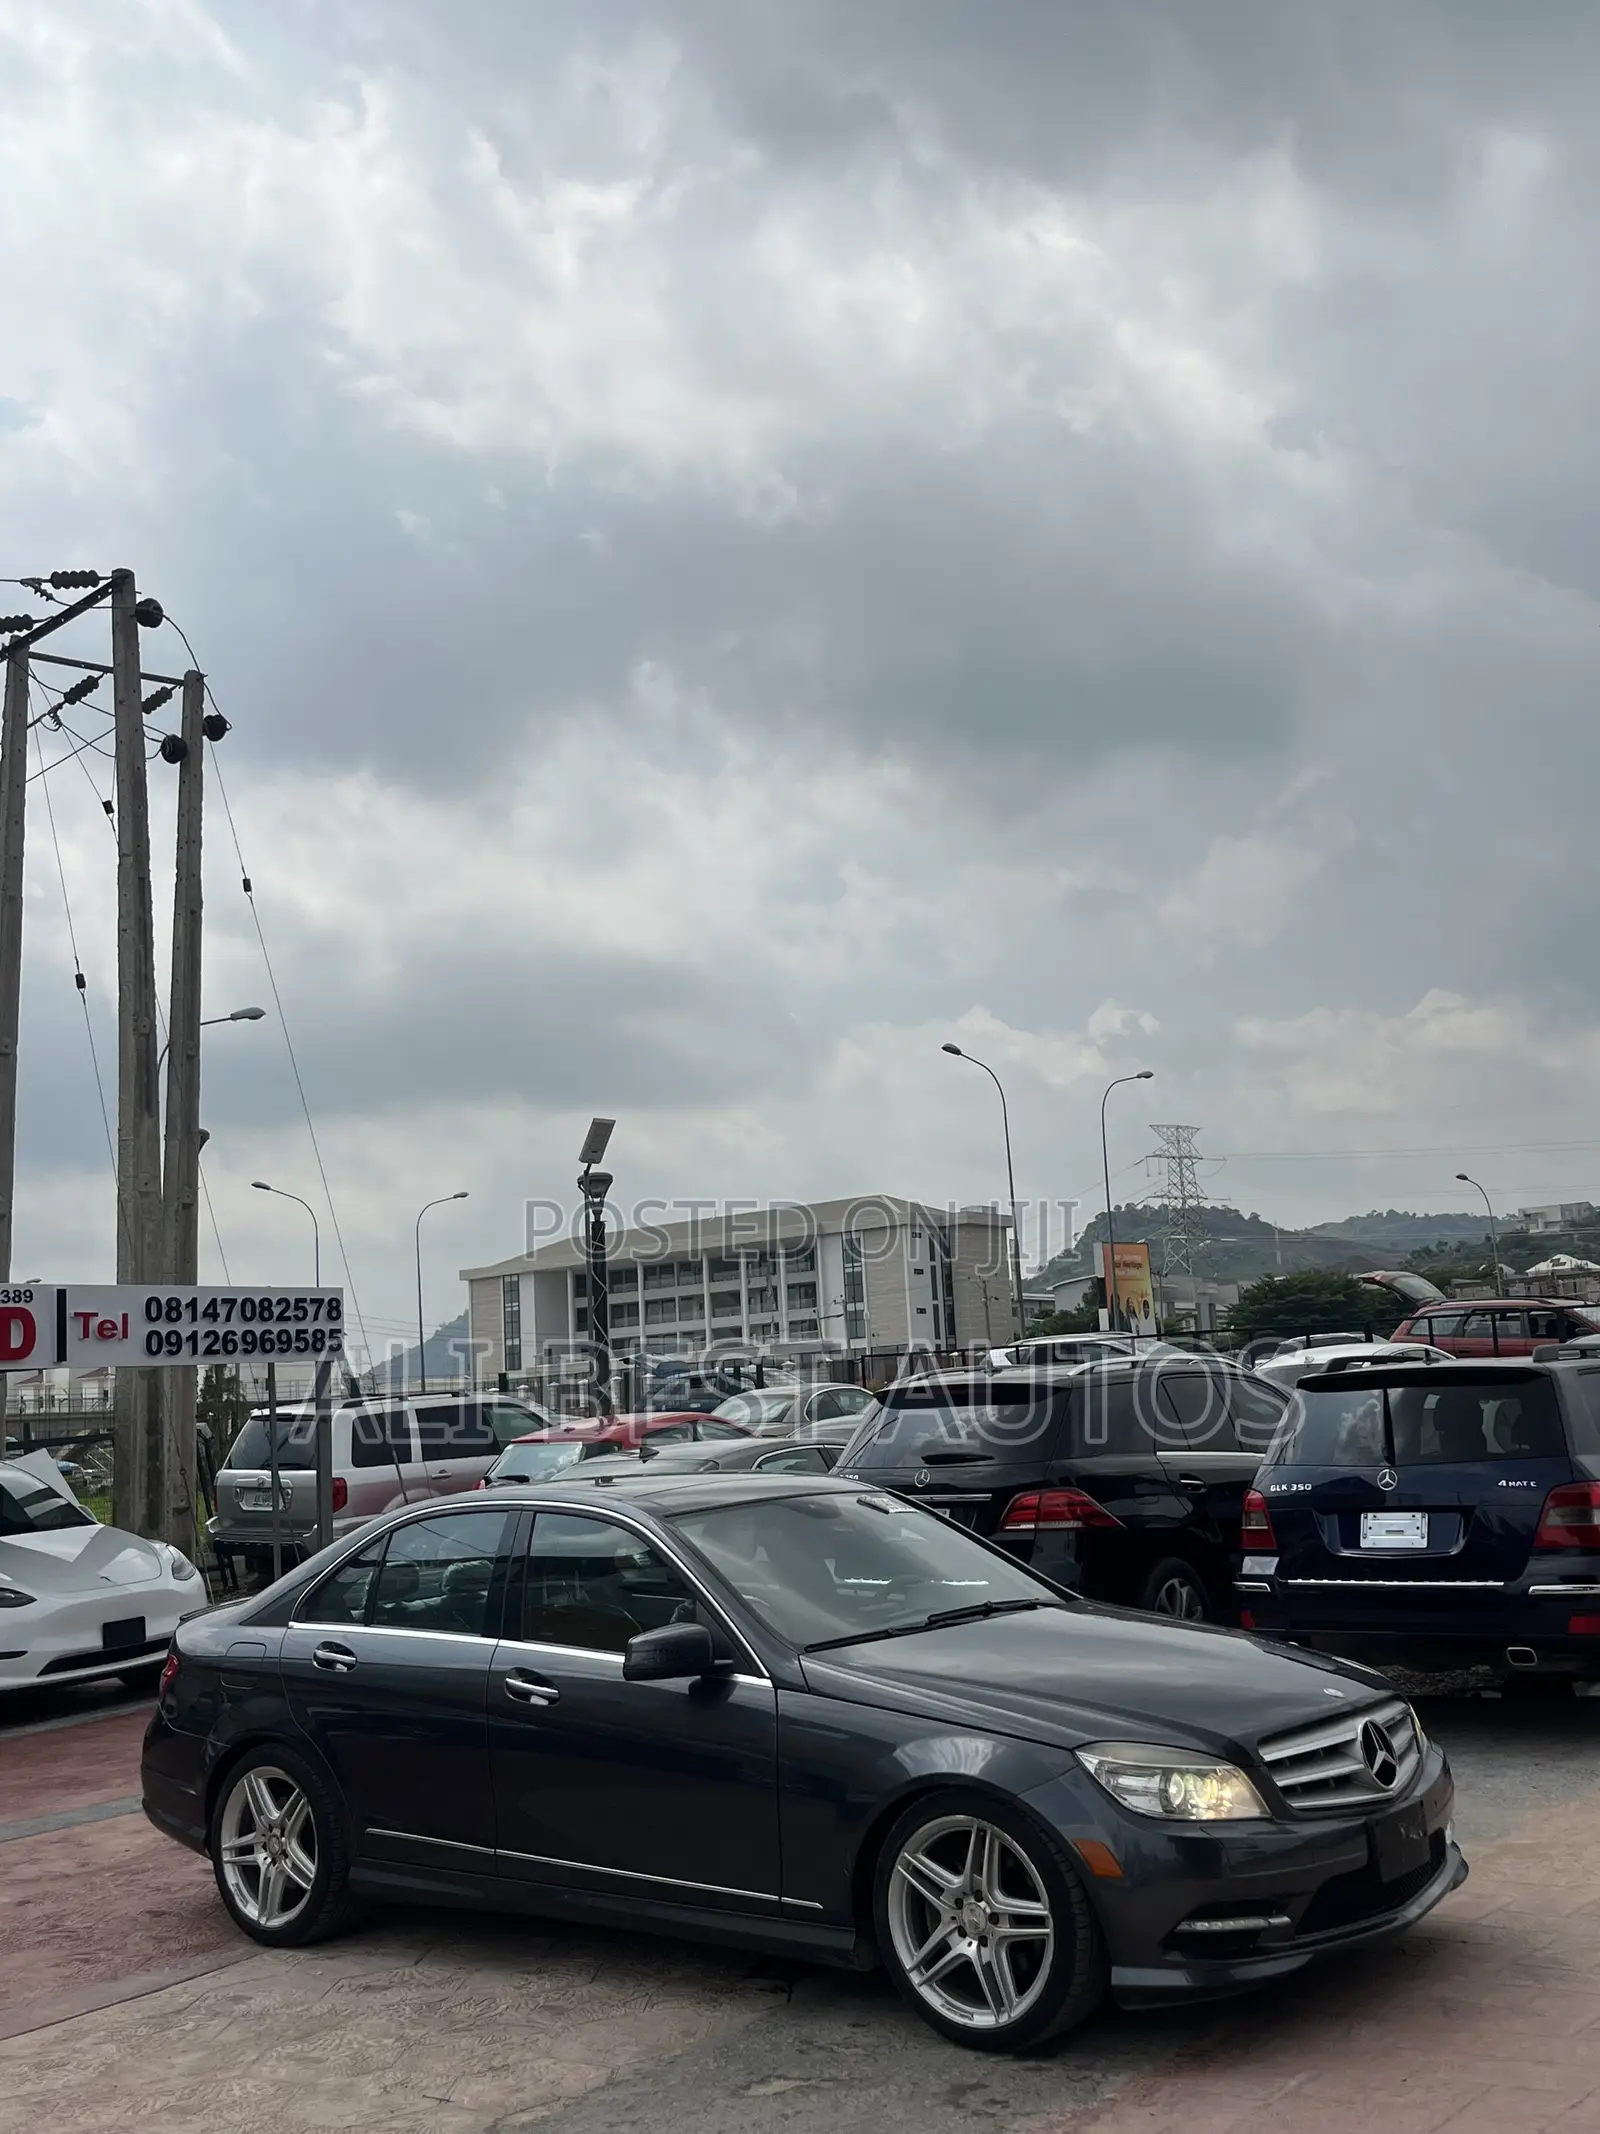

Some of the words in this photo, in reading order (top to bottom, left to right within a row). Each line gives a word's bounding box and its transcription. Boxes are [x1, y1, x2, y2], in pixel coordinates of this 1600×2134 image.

[144, 1296, 342, 1323] 08147082578
[73, 1311, 129, 1340] Tel
[145, 1328, 343, 1356] 09126969585
[1270, 1483, 1288, 1491] GLK
[1291, 1483, 1312, 1491] 350
